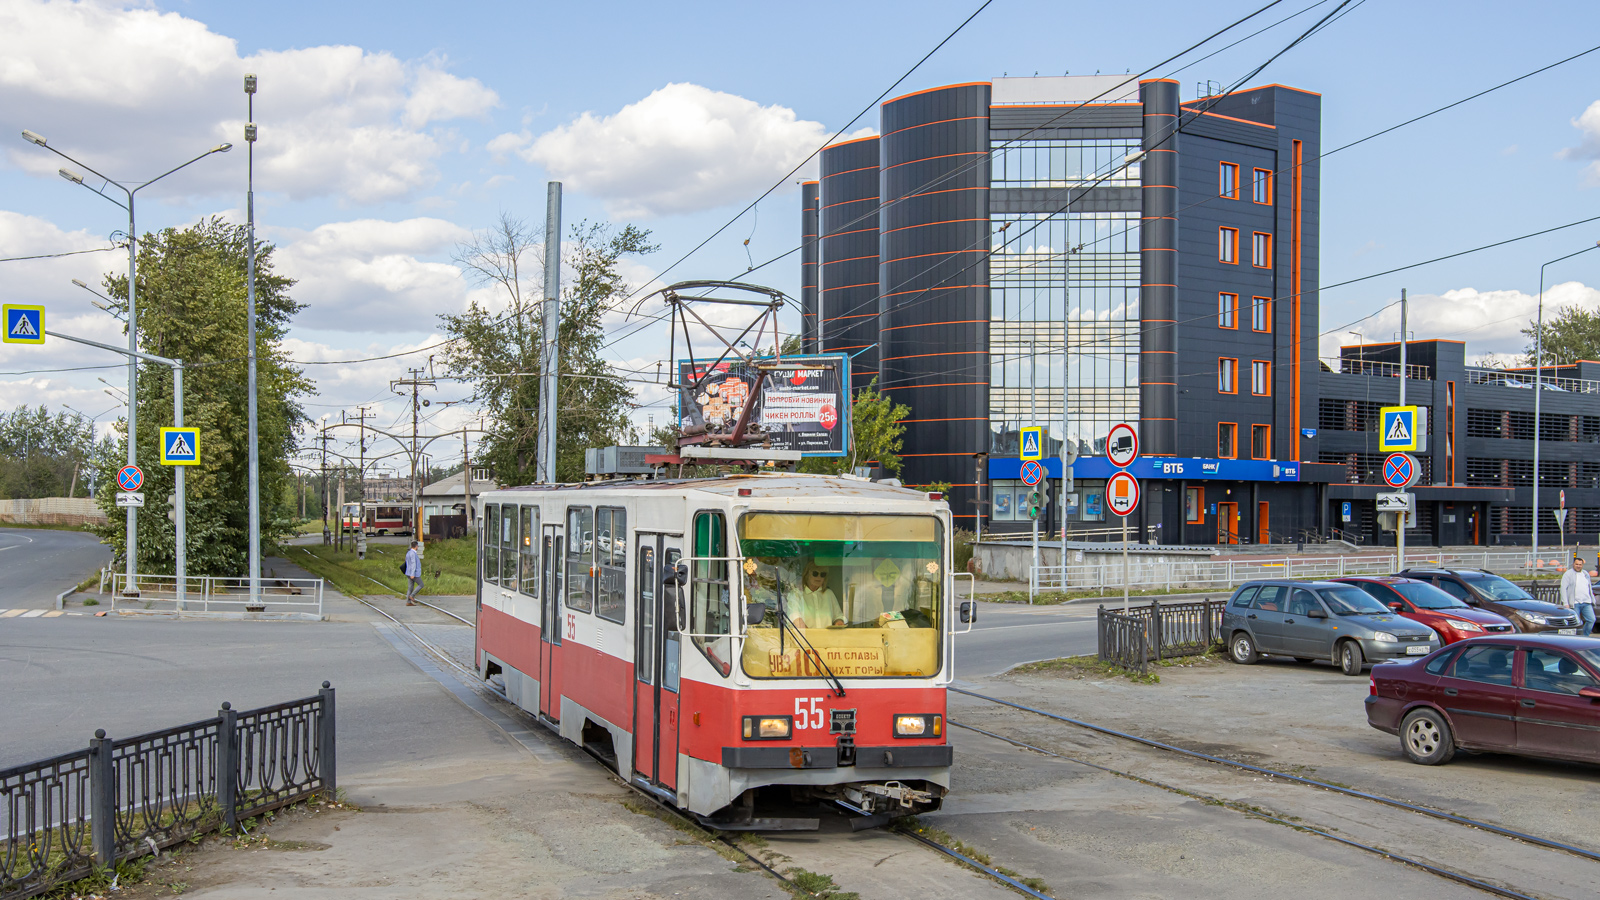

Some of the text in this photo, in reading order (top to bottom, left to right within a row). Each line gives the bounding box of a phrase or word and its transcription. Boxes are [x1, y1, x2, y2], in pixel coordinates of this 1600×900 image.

[1163, 463, 1184, 474] ВТБ
[1344, 504, 1348, 514] P
[568, 613, 575, 640] 55
[769, 654, 791, 673] УВЗ
[795, 648, 821, 677] 10
[827, 652, 879, 660] ПЛ. СЛАВЫ
[855, 666, 883, 675] ГОРЫ
[795, 697, 824, 729] 55
